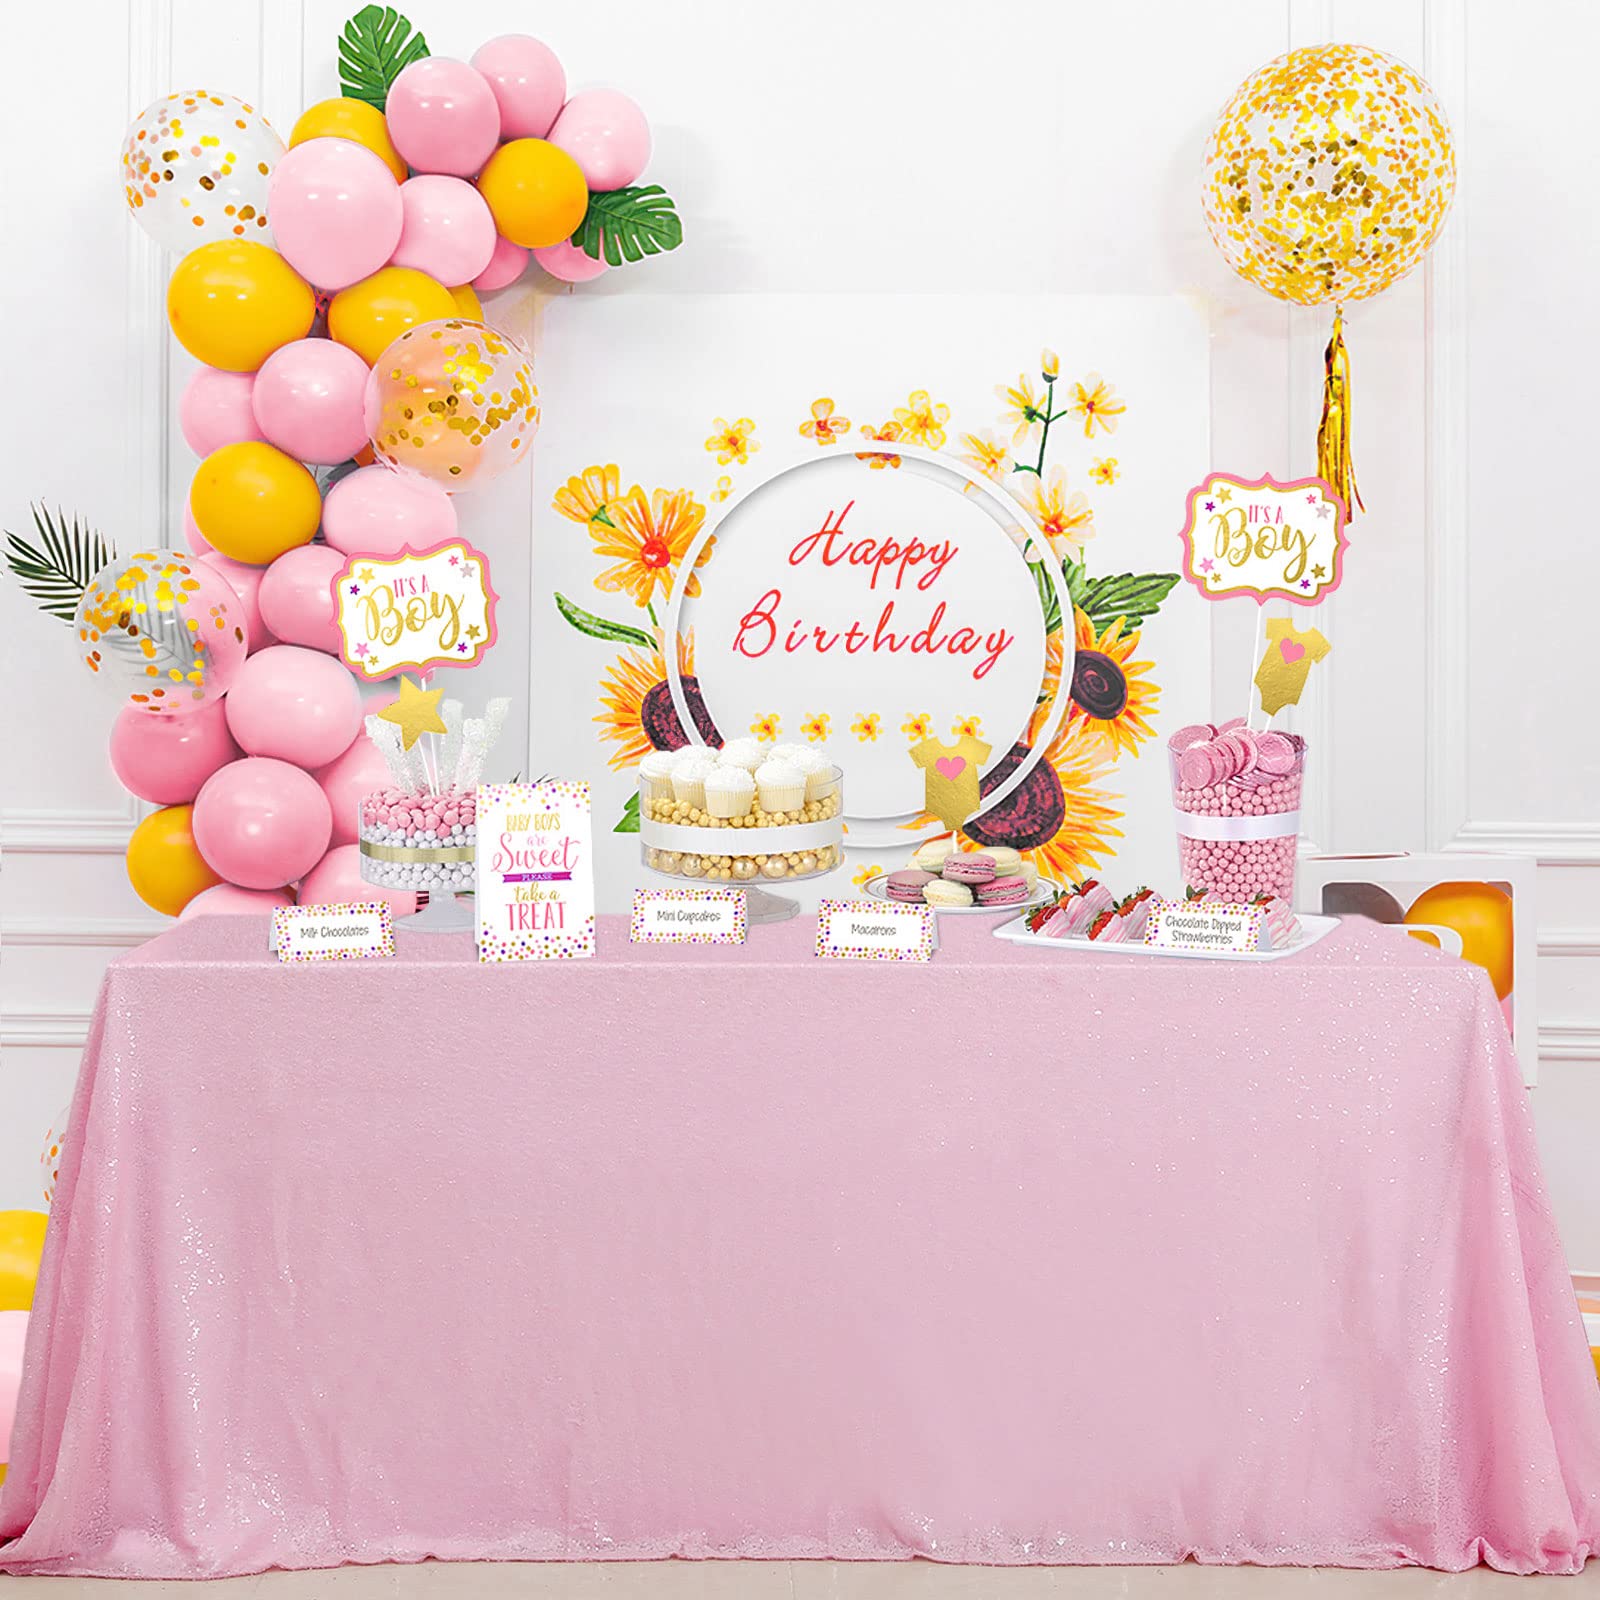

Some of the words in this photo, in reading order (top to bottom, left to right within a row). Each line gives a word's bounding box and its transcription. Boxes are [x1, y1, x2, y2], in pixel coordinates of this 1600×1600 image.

[1249, 504, 1271, 524] IT'S
[1275, 505, 1284, 524] A
[788, 500, 959, 590] Happy
[1208, 507, 1317, 583] Boy
[393, 576, 417, 598] IT'S
[421, 574, 430, 593] A
[356, 585, 465, 651] Boy
[732, 589, 1014, 679] Birthday
[506, 813, 531, 832] BABY
[534, 812, 561, 832] BOYS
[527, 834, 548, 847] are
[490, 832, 581, 873] Sweet
[521, 873, 554, 882] PLEASE
[513, 881, 547, 903] take
[549, 889, 560, 901] a
[505, 901, 567, 931] TREAT
[656, 910, 675, 922] Mini
[677, 910, 721, 925] Cupcakes
[1165, 915, 1209, 930] Chocolate
[1211, 918, 1242, 934] Dipped
[300, 927, 318, 939] Milk
[320, 926, 370, 938] Chocolates
[851, 923, 897, 936] Macarons
[1172, 930, 1234, 945] Strawberries
